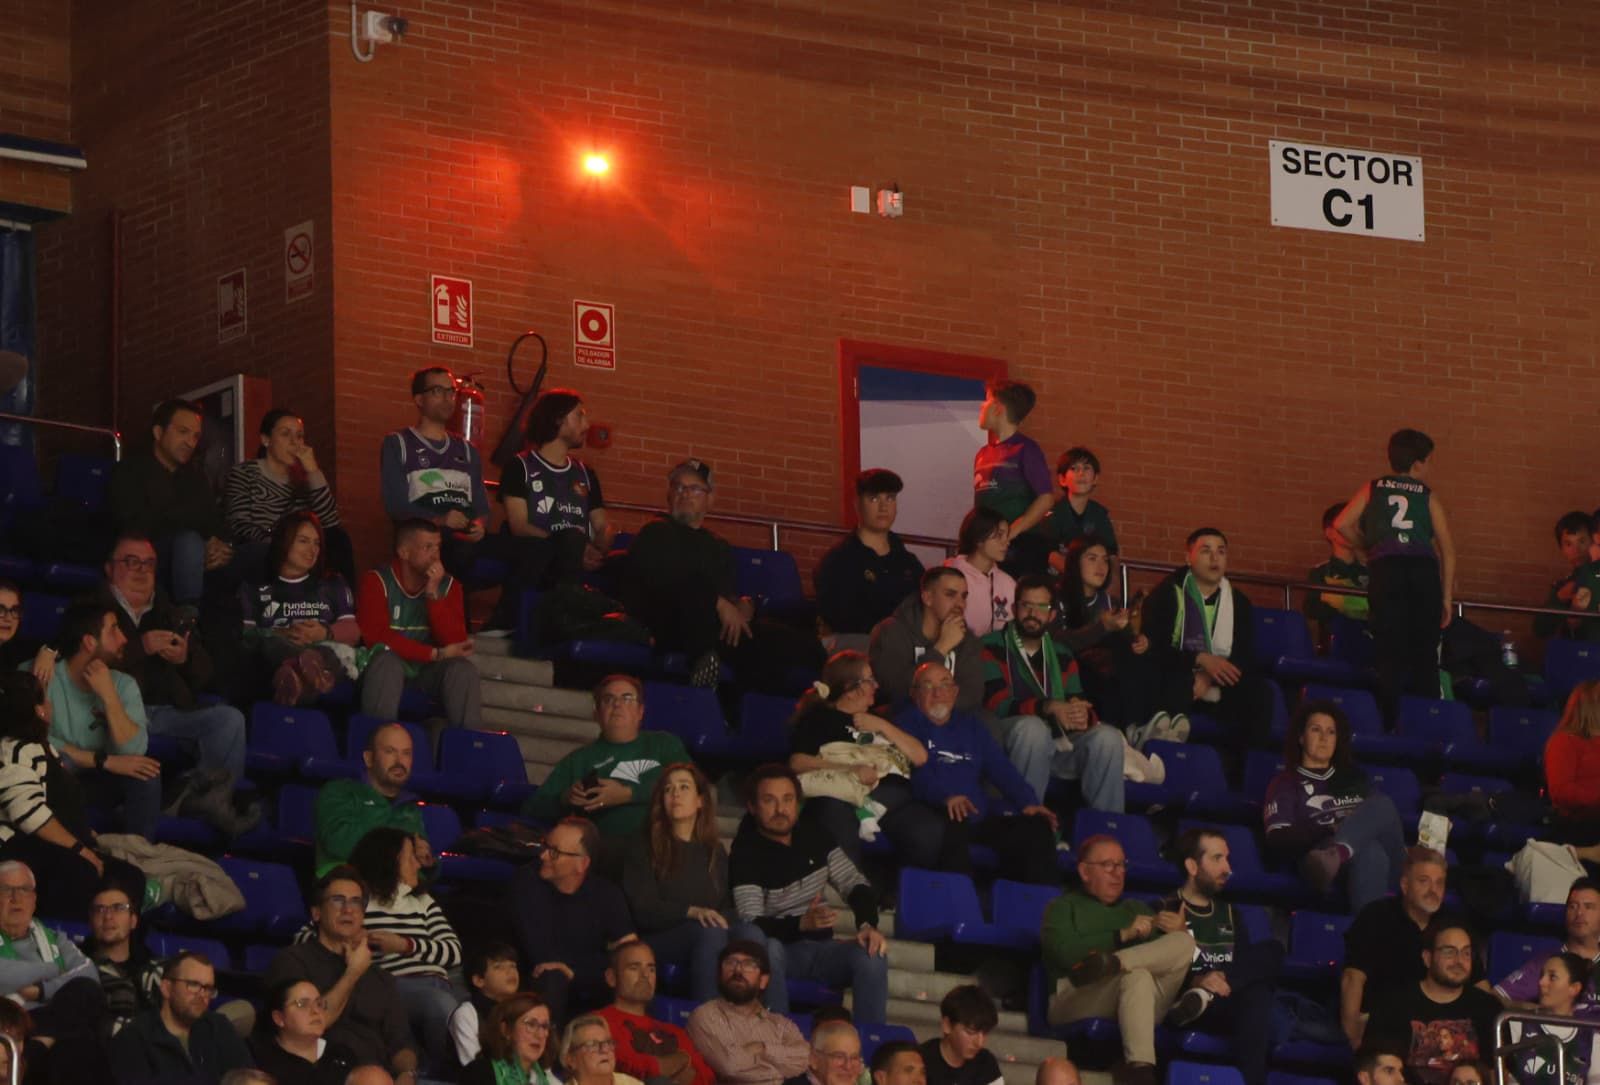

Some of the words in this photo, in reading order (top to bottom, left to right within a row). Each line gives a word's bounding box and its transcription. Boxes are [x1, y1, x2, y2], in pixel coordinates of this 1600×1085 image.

[1282, 147, 1413, 186] SECTOR
[1323, 188, 1374, 229] C1
[1387, 494, 1414, 530] 2
